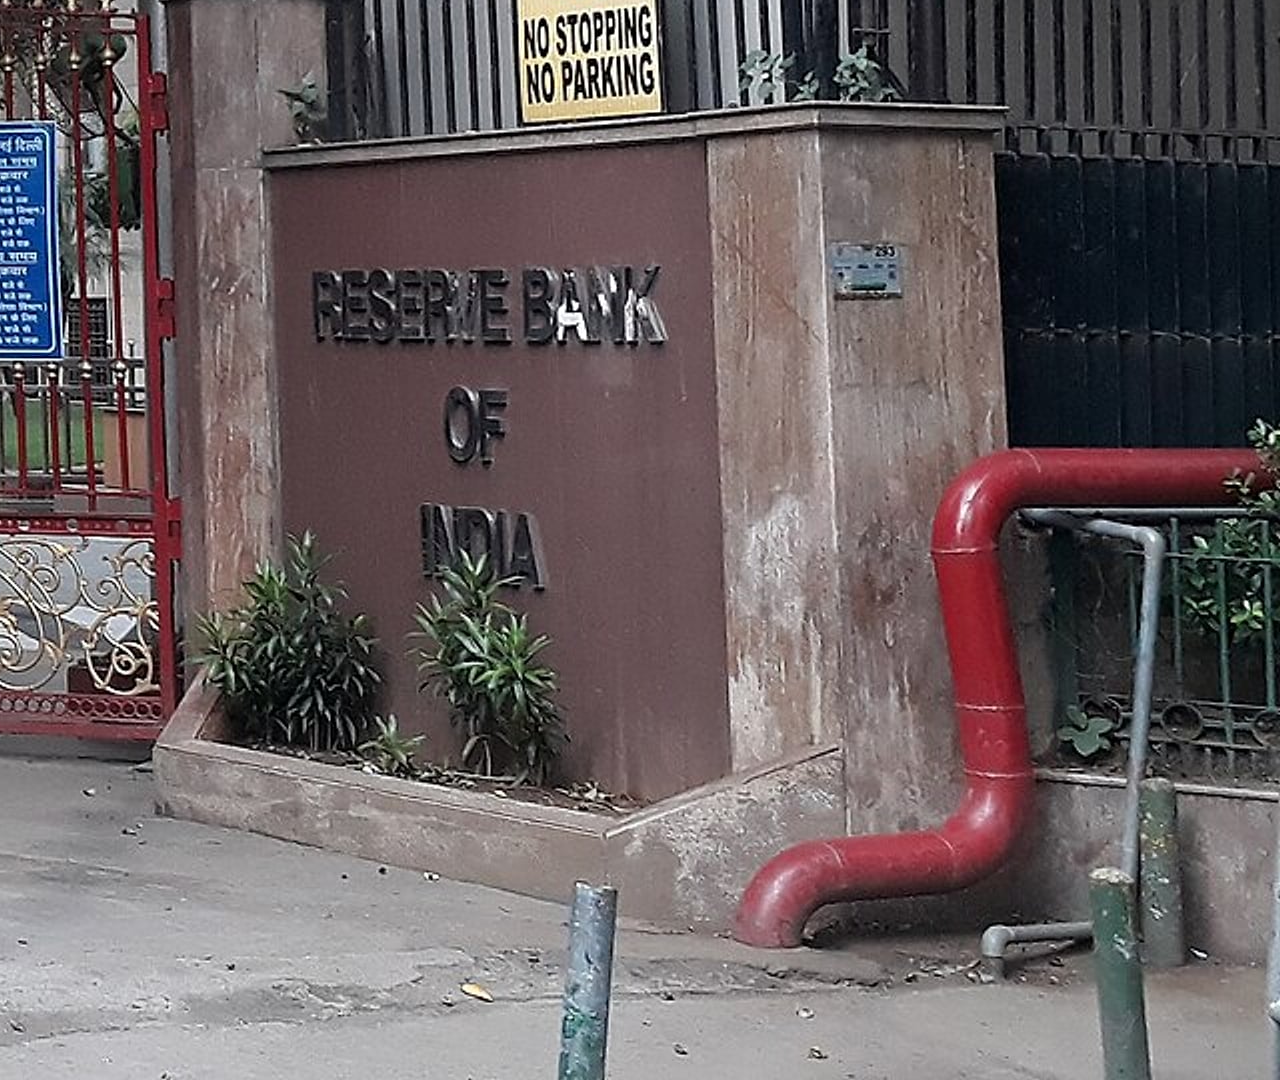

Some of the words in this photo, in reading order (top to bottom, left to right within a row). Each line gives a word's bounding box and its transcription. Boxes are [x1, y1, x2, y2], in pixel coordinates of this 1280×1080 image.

[524, 17, 550, 59] NO
[556, 5, 652, 56] STOPPING
[526, 61, 555, 104] NO
[562, 52, 655, 101] PARKING
[312, 267, 512, 344] RESERVE
[523, 263, 669, 346] BANK
[444, 385, 509, 465] OF
[419, 502, 549, 591] INDIA
